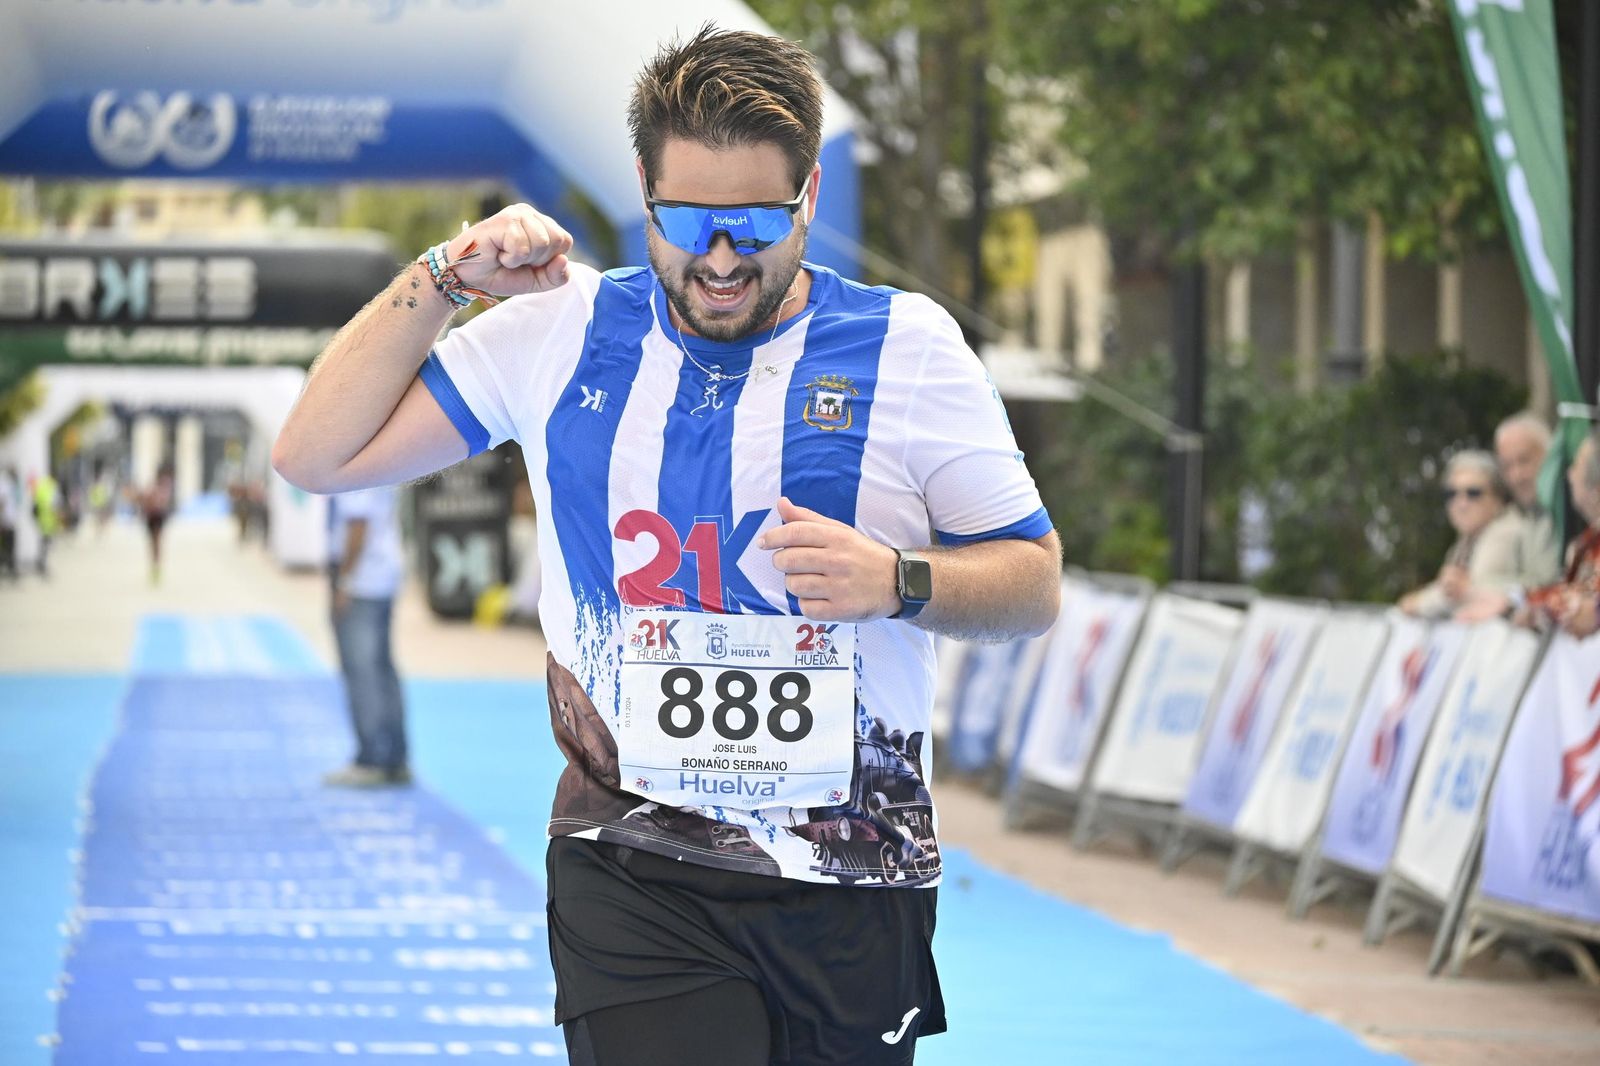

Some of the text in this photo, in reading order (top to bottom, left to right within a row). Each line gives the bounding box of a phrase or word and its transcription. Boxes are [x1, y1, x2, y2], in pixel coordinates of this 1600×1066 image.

[614, 508, 789, 614] 21K
[637, 619, 680, 650] 21K
[637, 649, 681, 661] HUELVA
[731, 648, 771, 658] HUELVA
[794, 654, 839, 666] HUELVA
[624, 697, 632, 728] 03.11.2024
[658, 667, 813, 742] 888
[713, 744, 757, 754] JOSE LUIS
[681, 756, 788, 771] BONAÑO SERRANO
[680, 772, 776, 797] Huelva
